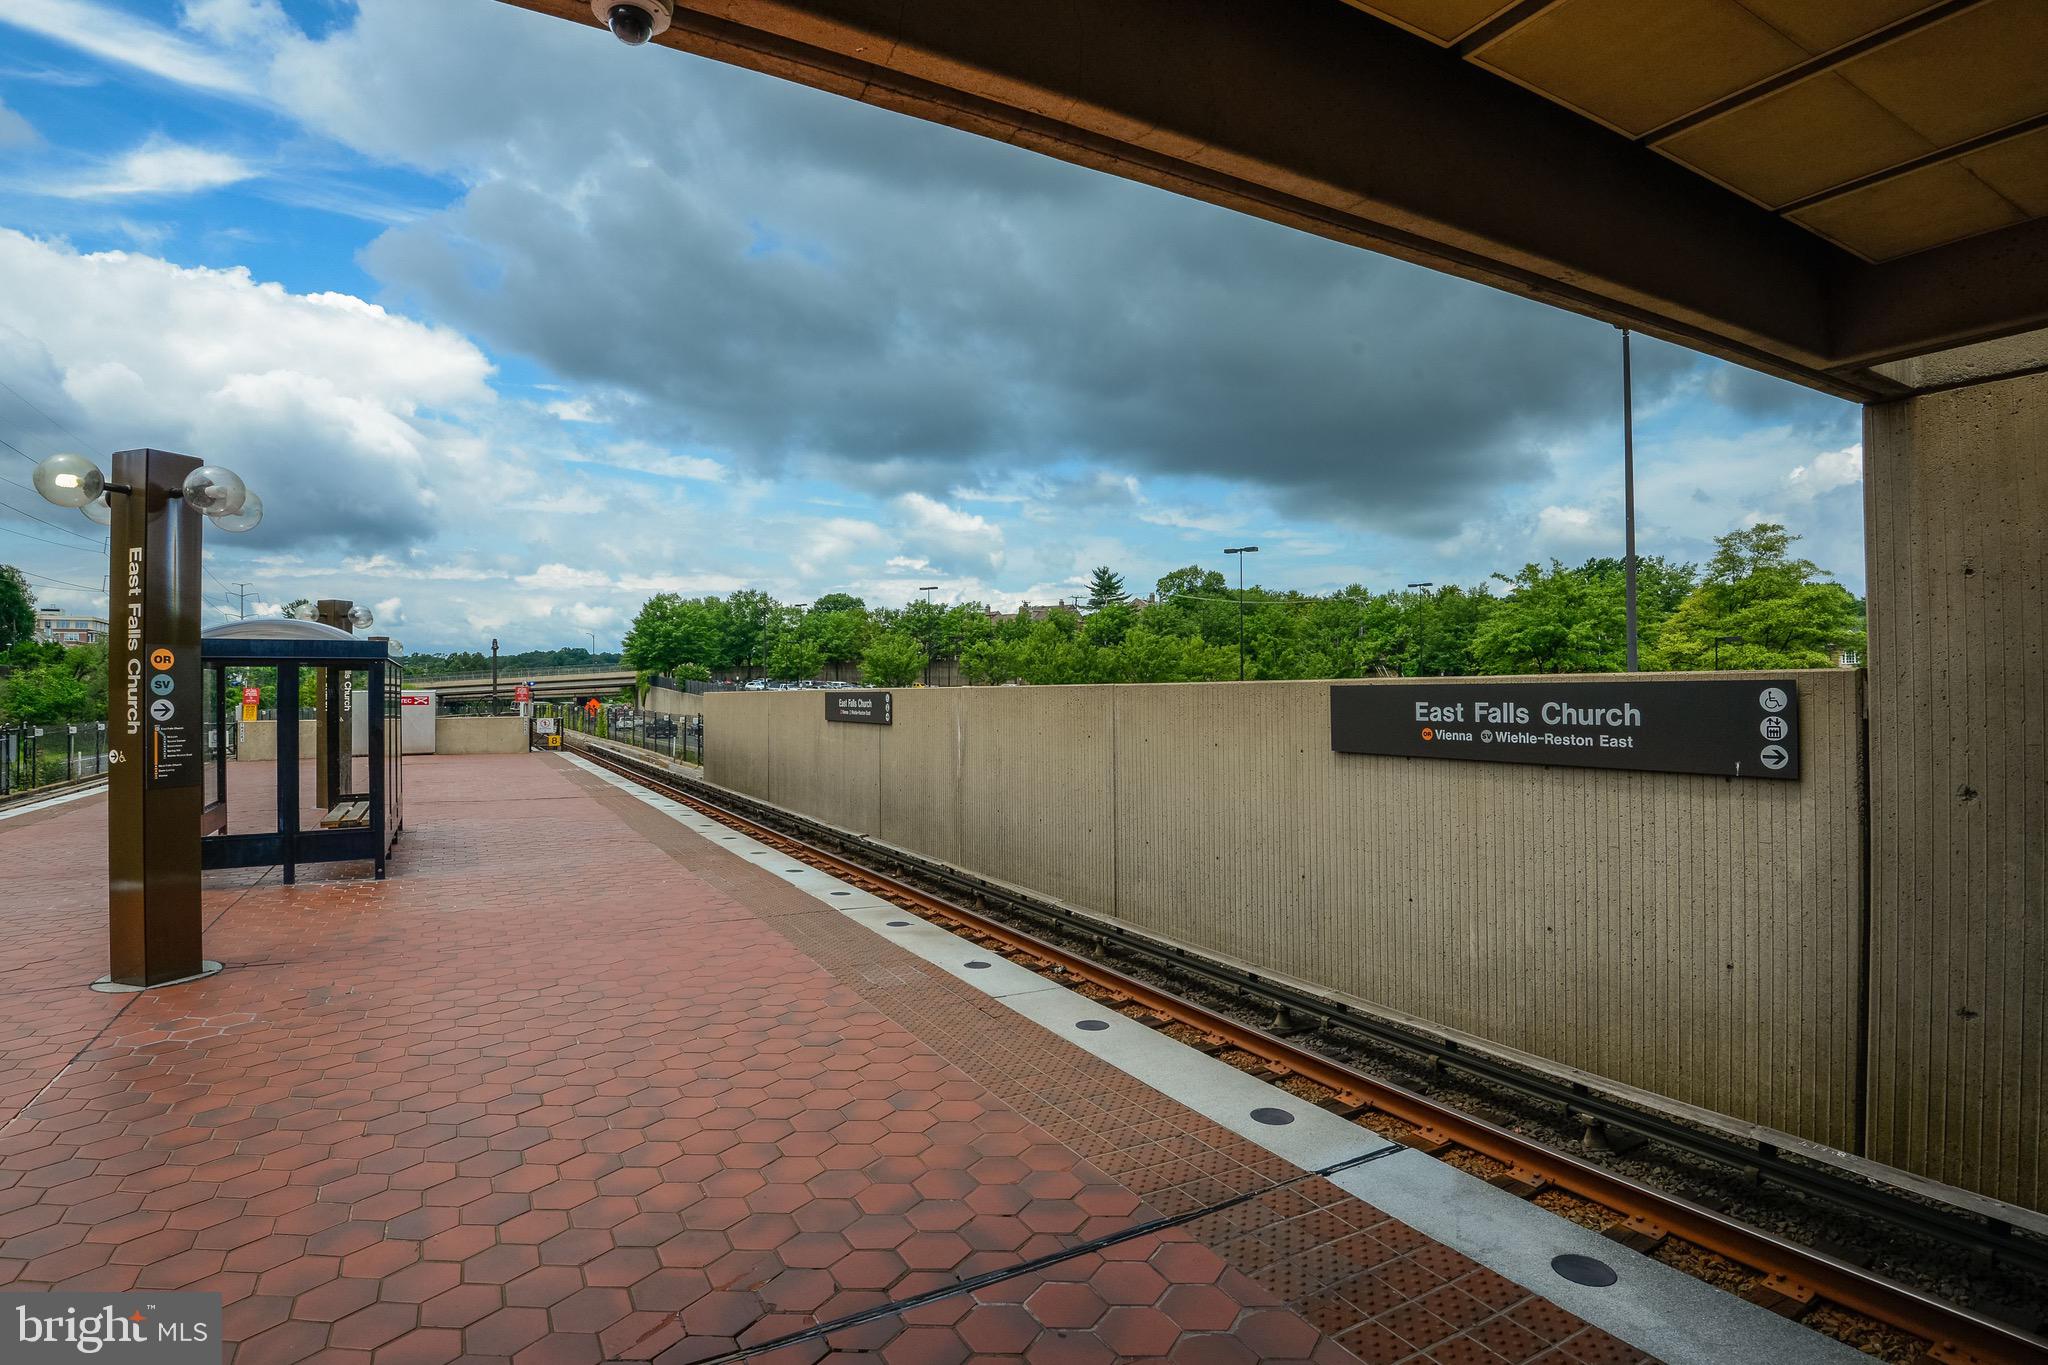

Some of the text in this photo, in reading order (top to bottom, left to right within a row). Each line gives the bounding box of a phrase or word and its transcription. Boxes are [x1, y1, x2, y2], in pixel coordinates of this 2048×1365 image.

[127, 547, 142, 735] East Falls Church
[154, 655, 171, 664] OR
[154, 681, 170, 689] SV
[344, 681, 352, 712] Church
[839, 699, 872, 708] East Falls Church
[1415, 701, 1641, 727] East Falls Church
[1434, 729, 1473, 742] Vienna
[1495, 731, 1594, 747] Wiehle-Reston
[1599, 732, 1634, 748] East
